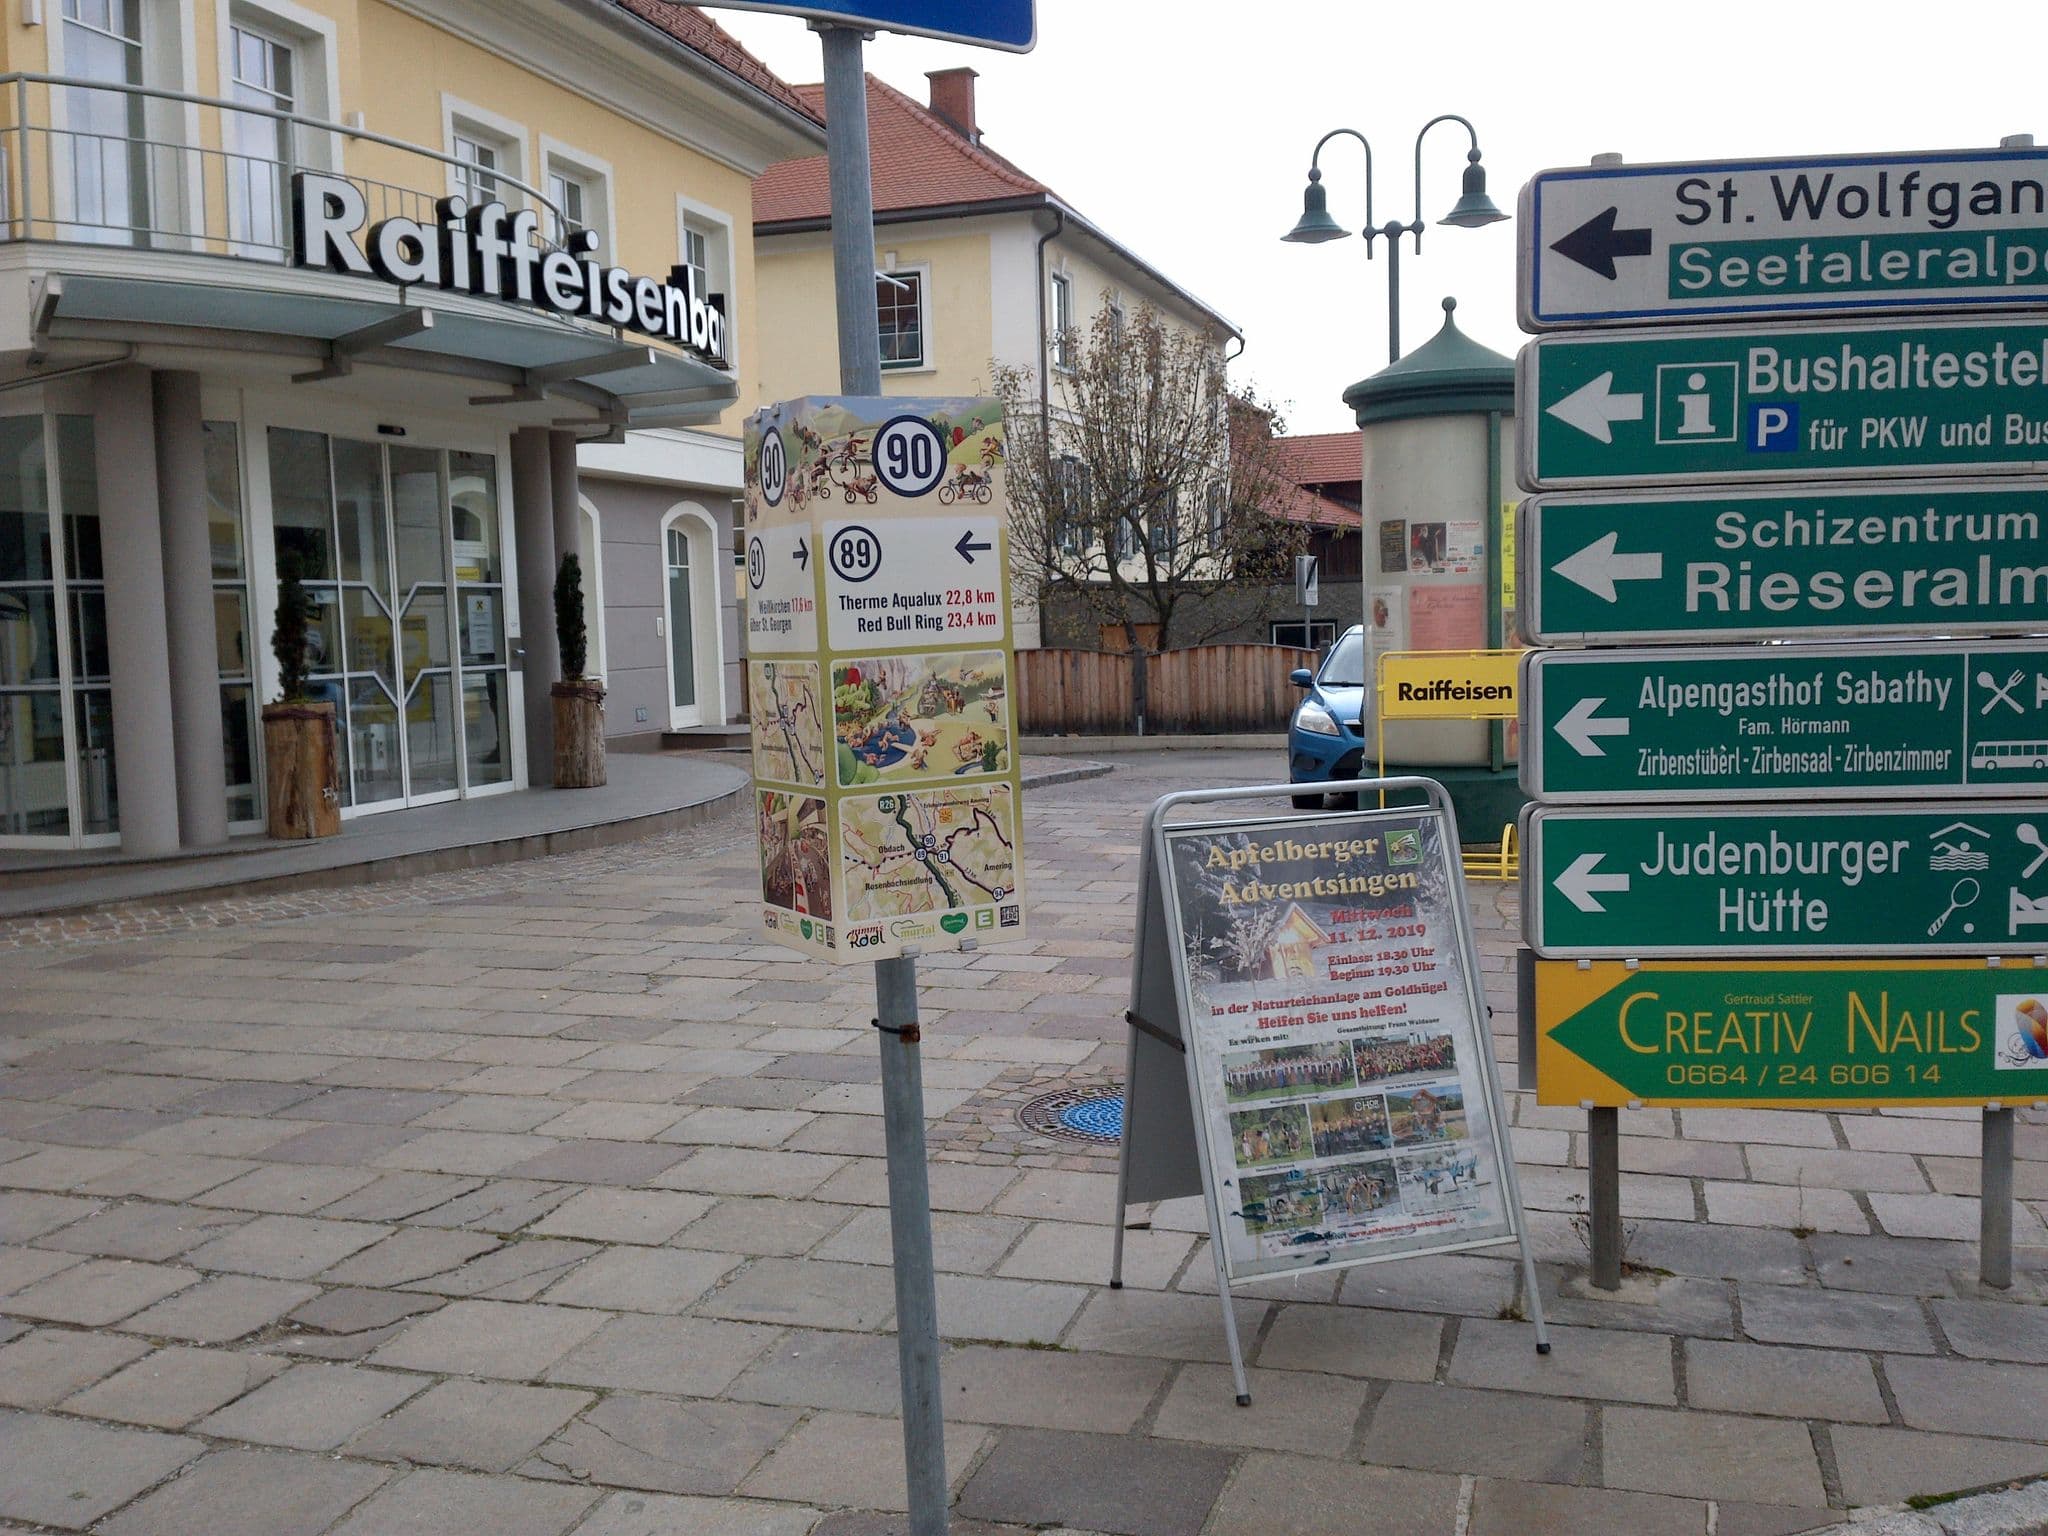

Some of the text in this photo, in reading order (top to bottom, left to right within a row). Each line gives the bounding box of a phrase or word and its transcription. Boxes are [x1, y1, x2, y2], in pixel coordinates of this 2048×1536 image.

[1675, 177, 1754, 225] St.
[294, 171, 729, 364] Raiffeisenban
[1678, 235, 2048, 289] Seetaleralp
[1809, 419, 1848, 451] für
[1861, 416, 1928, 449] PKW
[1941, 414, 1992, 447] und
[764, 442, 781, 491] 90
[887, 433, 933, 480] 90
[1714, 508, 2039, 550] Schizentrum
[751, 549, 761, 577] 91
[840, 538, 871, 569] 89
[1685, 554, 2048, 612] Rieseralm
[838, 589, 995, 611] Therme Aqualux 22,8 km
[857, 611, 996, 633] Red Bull Ring 23,4 km
[1398, 680, 1513, 702] Raiffeisen
[1638, 669, 1953, 717] Alpengasthof Sabathy
[1738, 715, 1850, 735] Fam. Hörmann
[878, 845, 905, 854] Obdach
[1205, 835, 1380, 872] Apfelberger
[1640, 830, 1910, 886] Judenburger
[984, 862, 1013, 871] Amering
[1218, 869, 1419, 905] Adventsingen
[1330, 904, 1413, 923] Mittwoch
[1719, 887, 1829, 933] Hütte
[1328, 923, 1426, 944] 11. 12. 2019
[1328, 946, 1435, 966] Einlass: 18.30 Uhr
[1330, 961, 1437, 982] Beginn: 19.30 Uhr
[1211, 980, 1448, 1017] in der Naturteichanlage am Goldhügel
[1724, 992, 1813, 1005] Gertraud Sattler
[1306, 1011, 1329, 1025] Sie
[1332, 1008, 1357, 1022] uns
[1359, 1002, 1408, 1018] helfen!
[1229, 1038, 1239, 1047] Es
[1240, 1035, 1271, 1045] wirken
[1666, 1063, 1942, 1087] 0664 / 24 606 14
